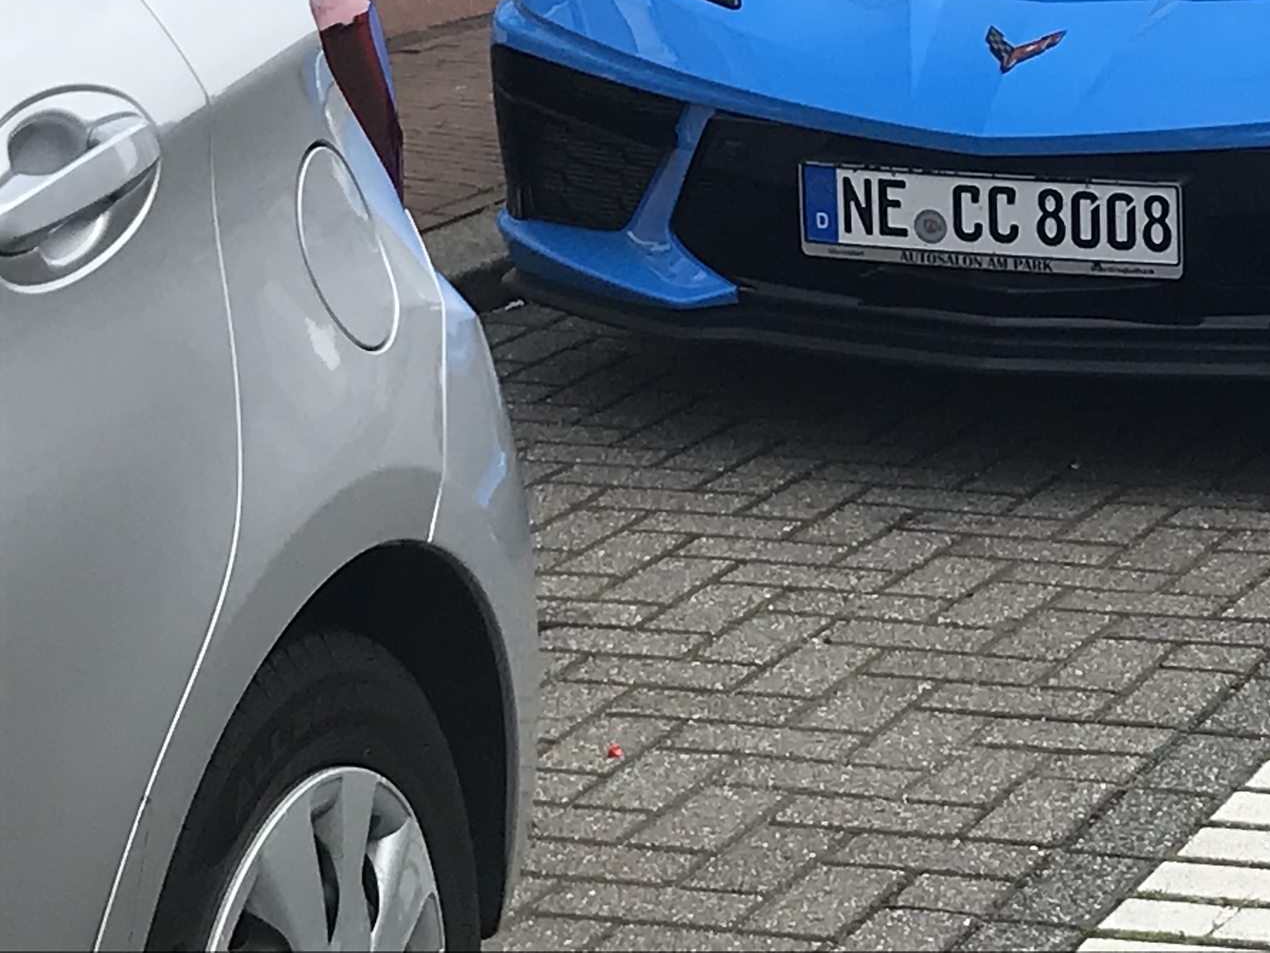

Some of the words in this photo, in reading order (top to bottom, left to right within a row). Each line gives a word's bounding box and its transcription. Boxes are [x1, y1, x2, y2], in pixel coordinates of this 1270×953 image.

[816, 212, 829, 229] D
[842, 176, 909, 238] NE
[952, 184, 1019, 244] CC
[1036, 188, 1172, 253] 8008
[901, 251, 983, 268] AUTOSALON
[987, 256, 1009, 271] AM
[1013, 258, 1053, 273] PARK
